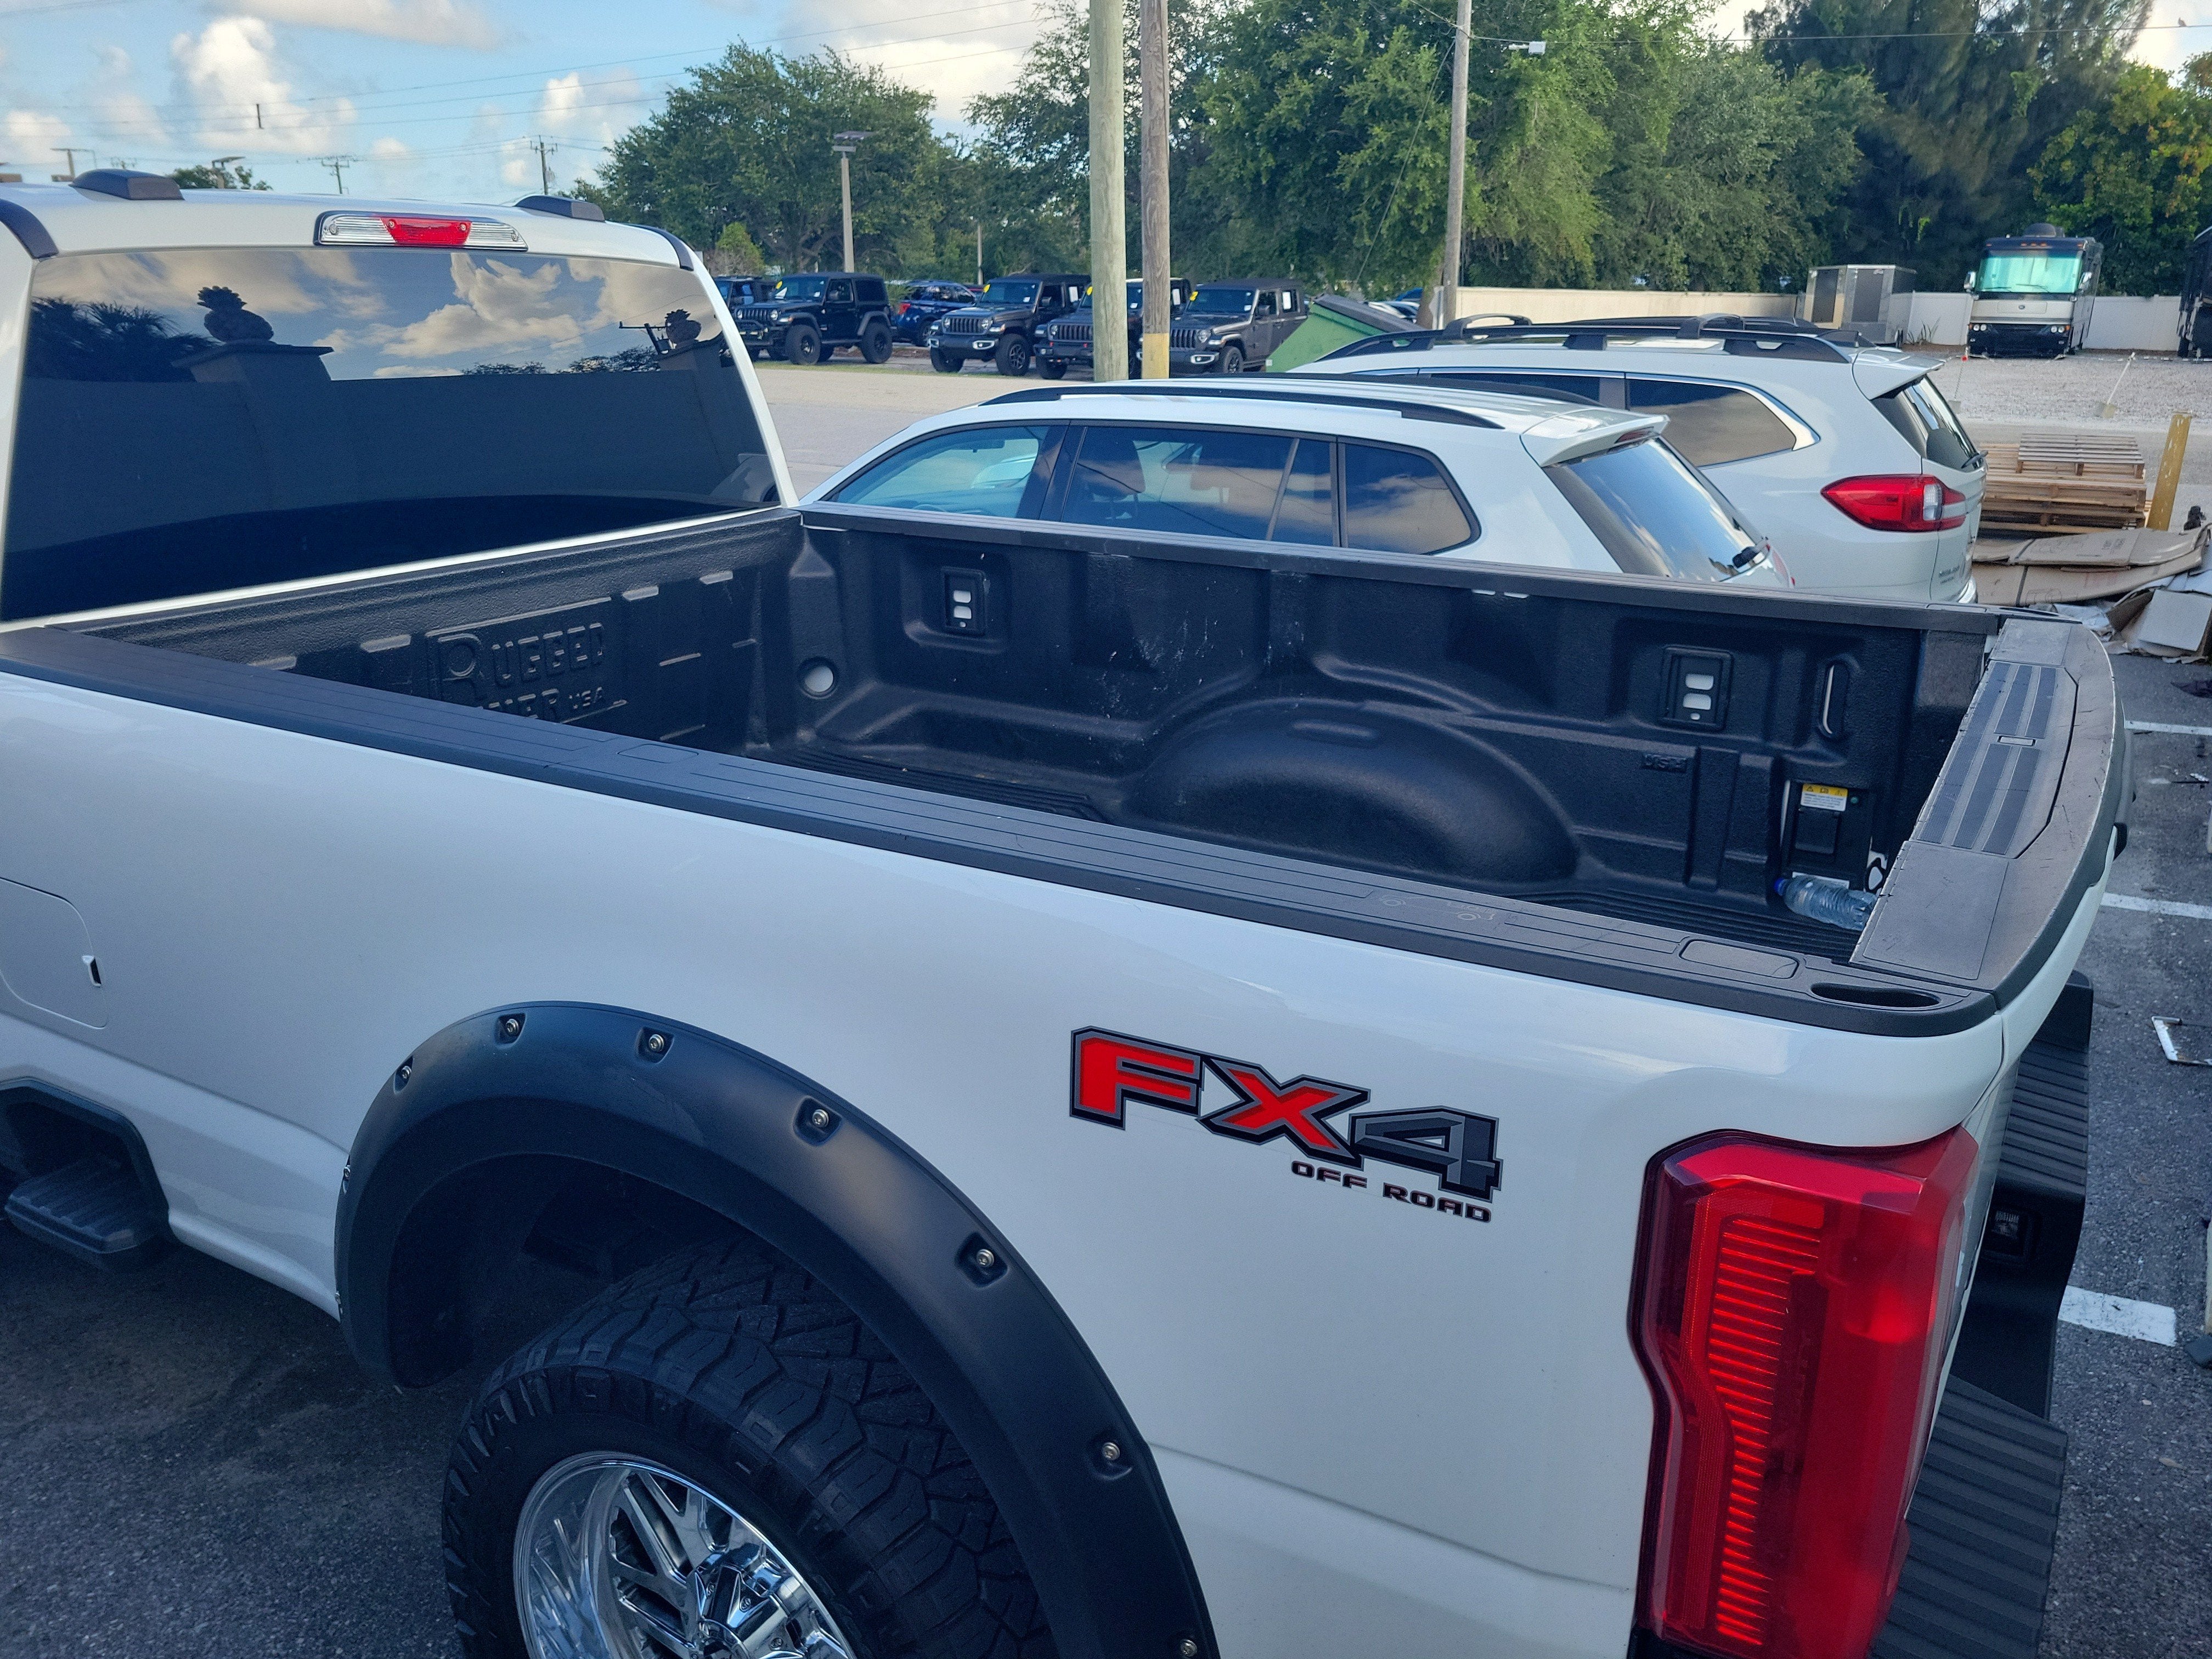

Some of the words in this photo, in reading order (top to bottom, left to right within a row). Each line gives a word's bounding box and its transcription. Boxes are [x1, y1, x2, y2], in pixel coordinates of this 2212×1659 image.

[1070, 1025, 1504, 1203] FX4
[1290, 1159, 1368, 1189] OFF
[1383, 1181, 1492, 1223] ROAD
